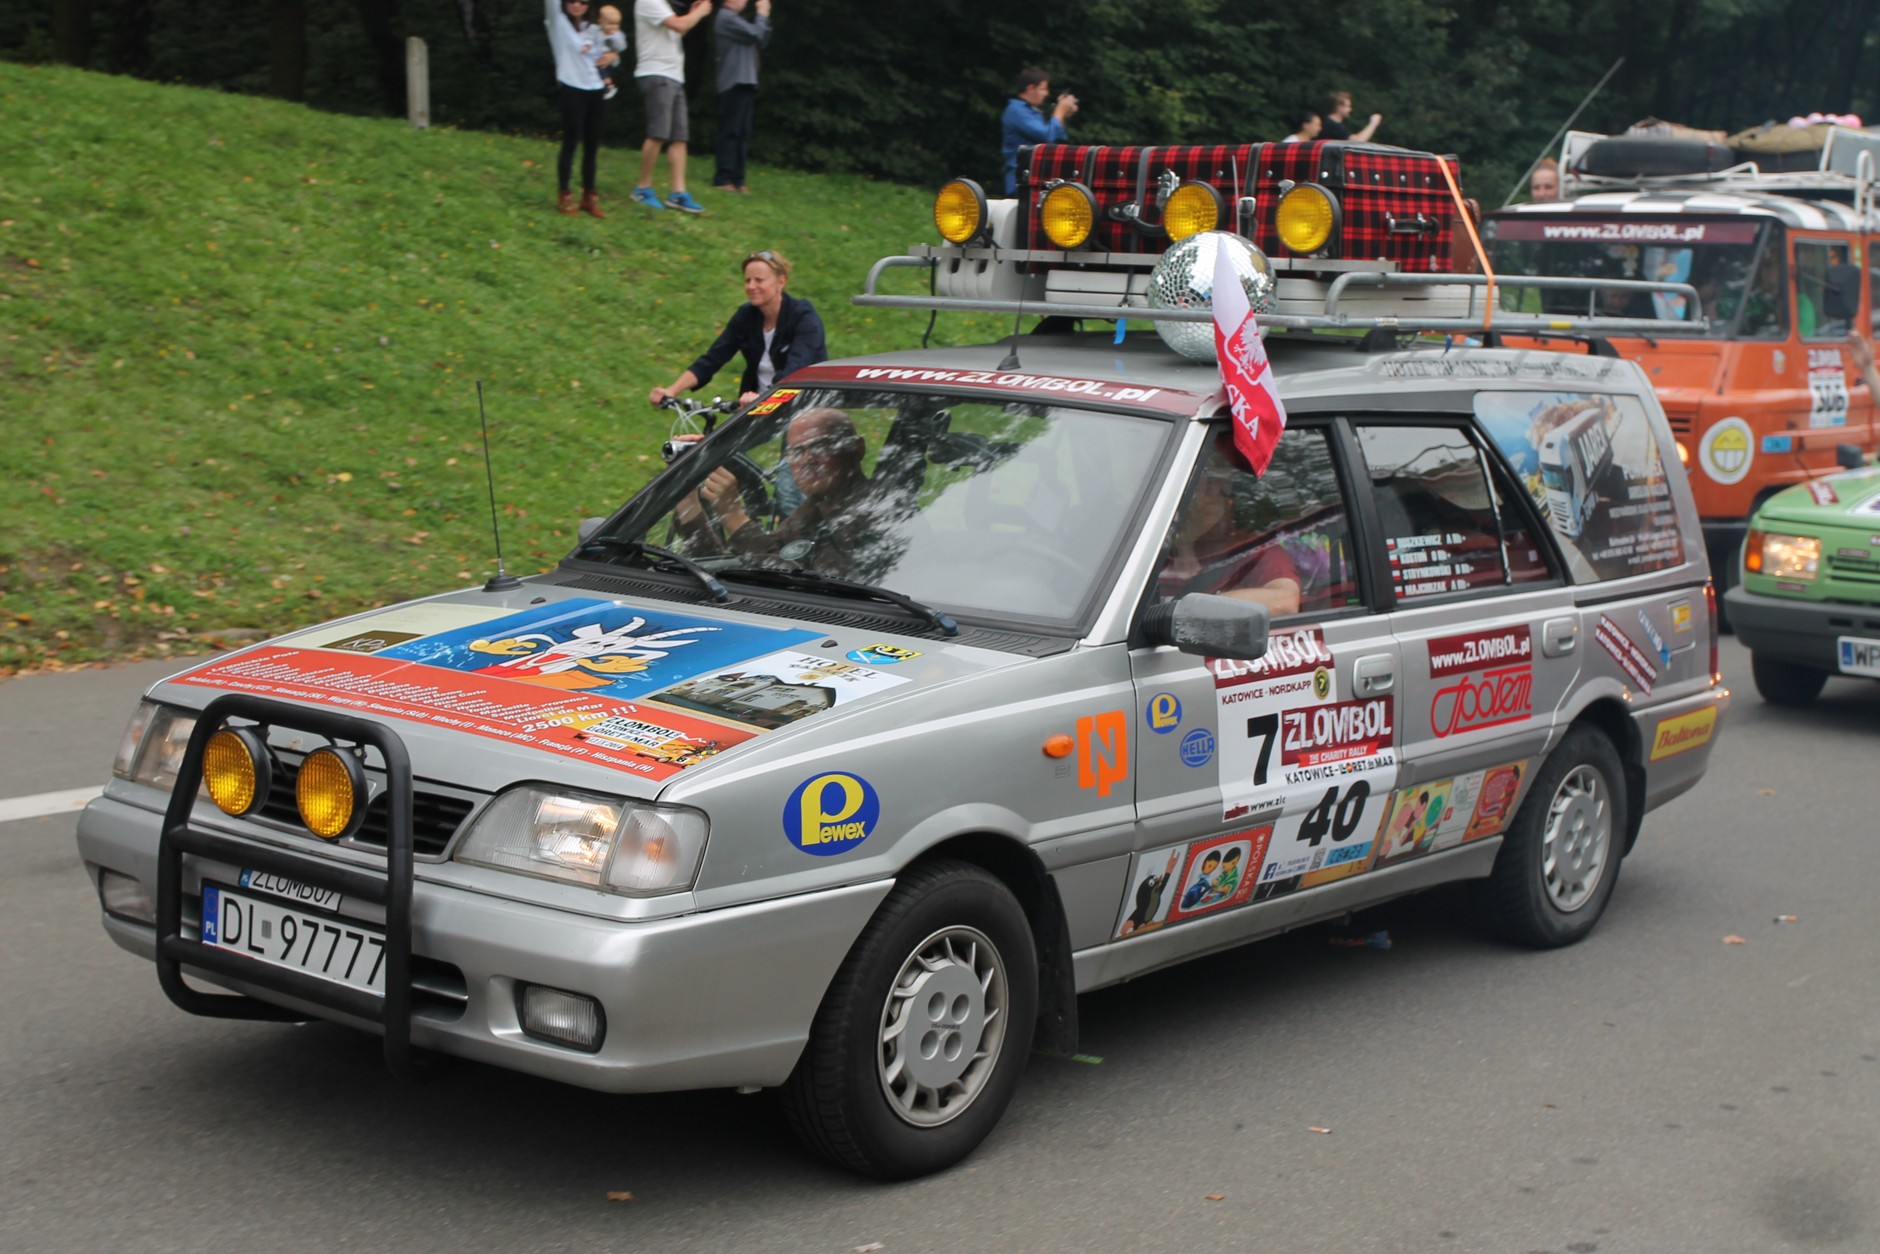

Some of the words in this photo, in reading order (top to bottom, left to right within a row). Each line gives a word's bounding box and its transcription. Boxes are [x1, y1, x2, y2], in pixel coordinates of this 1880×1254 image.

[272, 650, 298, 659] Pole
[1222, 688, 1264, 705] KATOWICE
[1269, 681, 1312, 696] NORDKAPP
[480, 701, 529, 716] Marseille
[504, 704, 564, 720] Montpellier
[516, 711, 554, 723] Lloret
[558, 707, 573, 715] de
[576, 701, 602, 712] Mar
[522, 715, 573, 733] 2500
[578, 707, 608, 722] km
[476, 725, 512, 737] Monaco
[511, 731, 536, 743] (MC)
[539, 739, 573, 752] Francja
[571, 746, 588, 756] (F)
[591, 752, 637, 768] Hiszpania
[634, 762, 655, 773] (H)
[630, 735, 659, 747] MAR
[1182, 737, 1215, 756] HELLA
[1247, 713, 1278, 786] 7
[1321, 750, 1347, 762] CHARITY
[1348, 746, 1367, 759] RALLY
[1375, 756, 1394, 768] MAR
[801, 774, 865, 846] Pewex
[1296, 780, 1370, 847] 40
[205, 921, 216, 936] PL
[222, 897, 265, 955] DL
[280, 914, 387, 986] 97777
